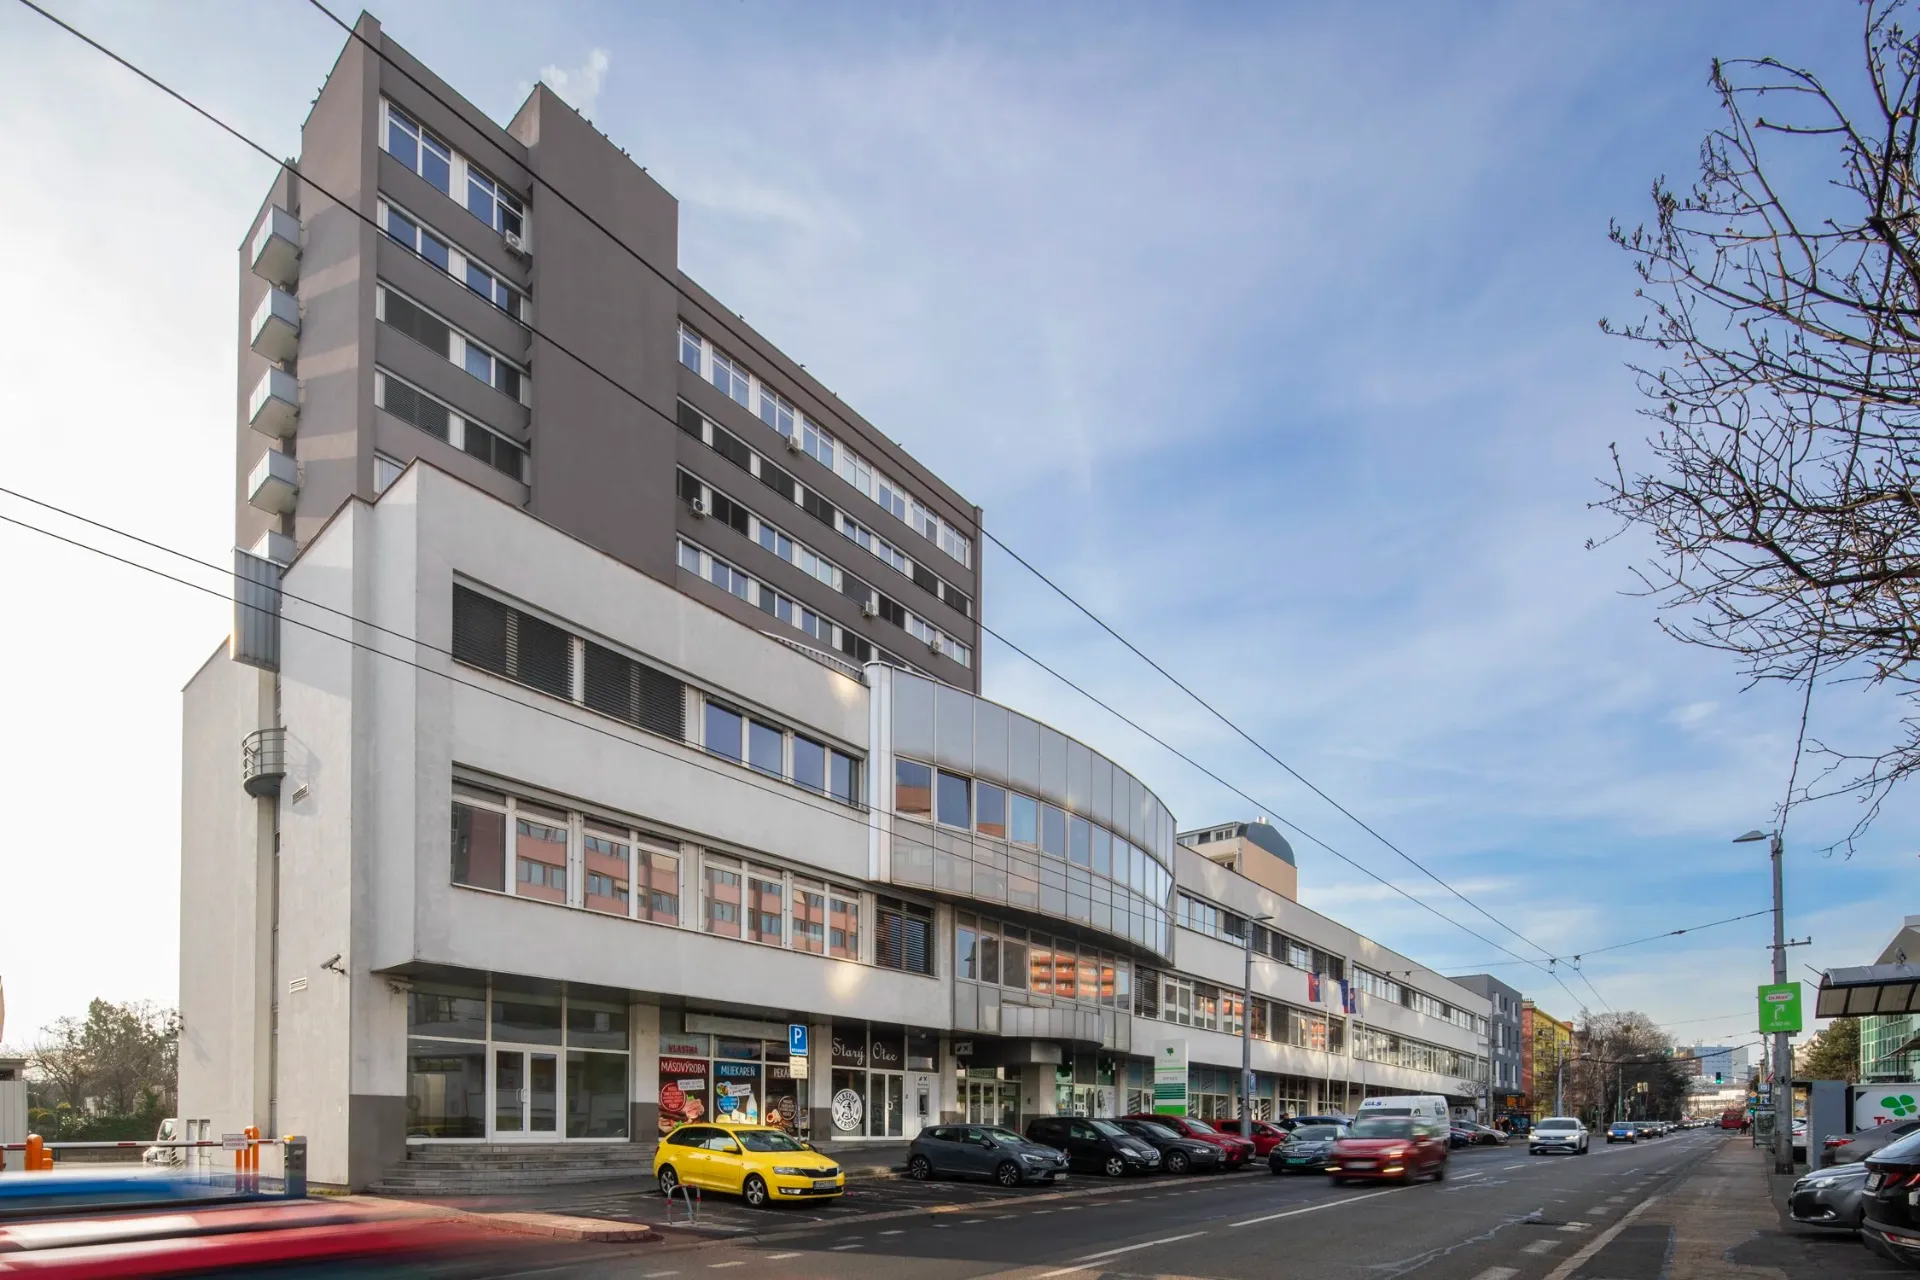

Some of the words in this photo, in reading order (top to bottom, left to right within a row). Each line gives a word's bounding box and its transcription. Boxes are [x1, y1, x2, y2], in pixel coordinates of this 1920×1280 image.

[794, 1027, 803, 1045] P
[831, 1037, 866, 1066] Starý
[872, 1041, 898, 1061] Otec
[660, 1060, 706, 1074] MÄSOVÝROBA
[720, 1064, 756, 1077] MLIEKAREŇ
